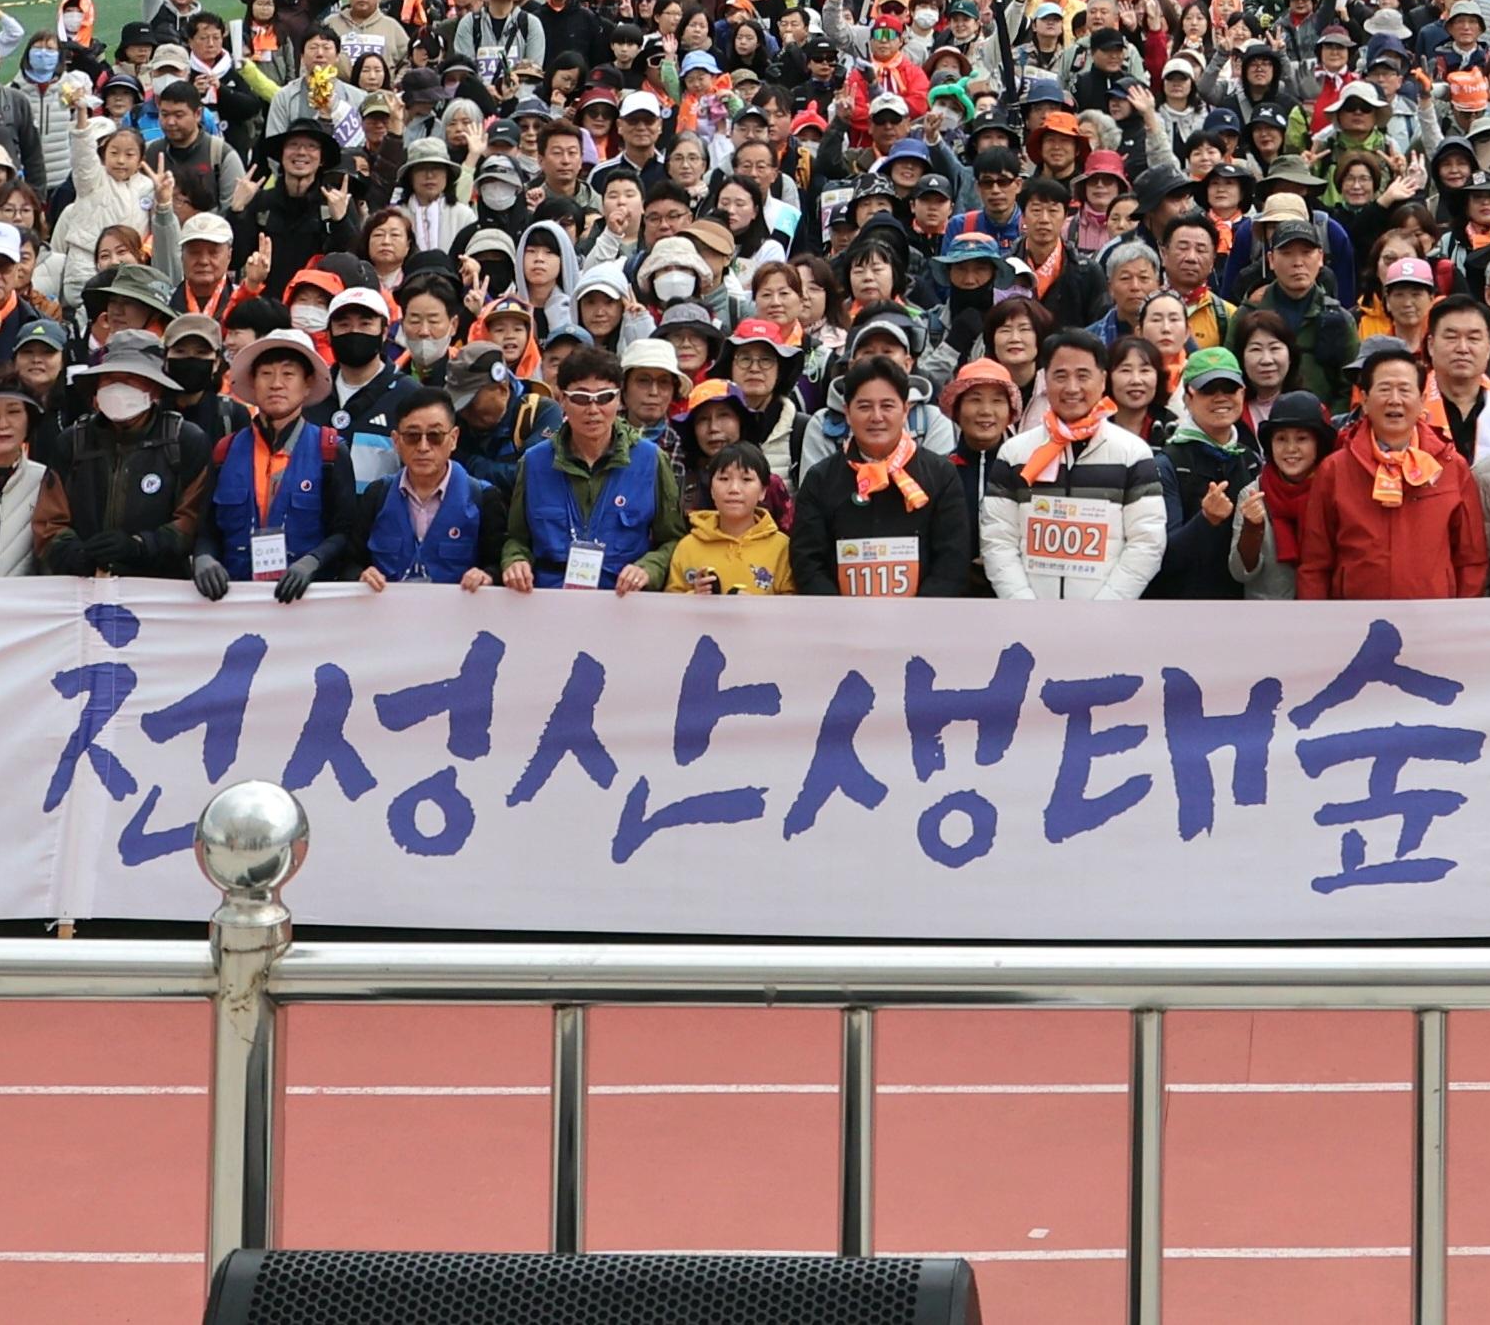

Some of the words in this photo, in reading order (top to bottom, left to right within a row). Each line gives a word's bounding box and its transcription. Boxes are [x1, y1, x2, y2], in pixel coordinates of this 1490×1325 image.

[478, 57, 517, 74] 342
[1402, 262, 1415, 275] S
[1032, 522, 1102, 556] 1002
[846, 564, 910, 596] 1115
[43, 601, 1488, 895] 천성산생태숲
